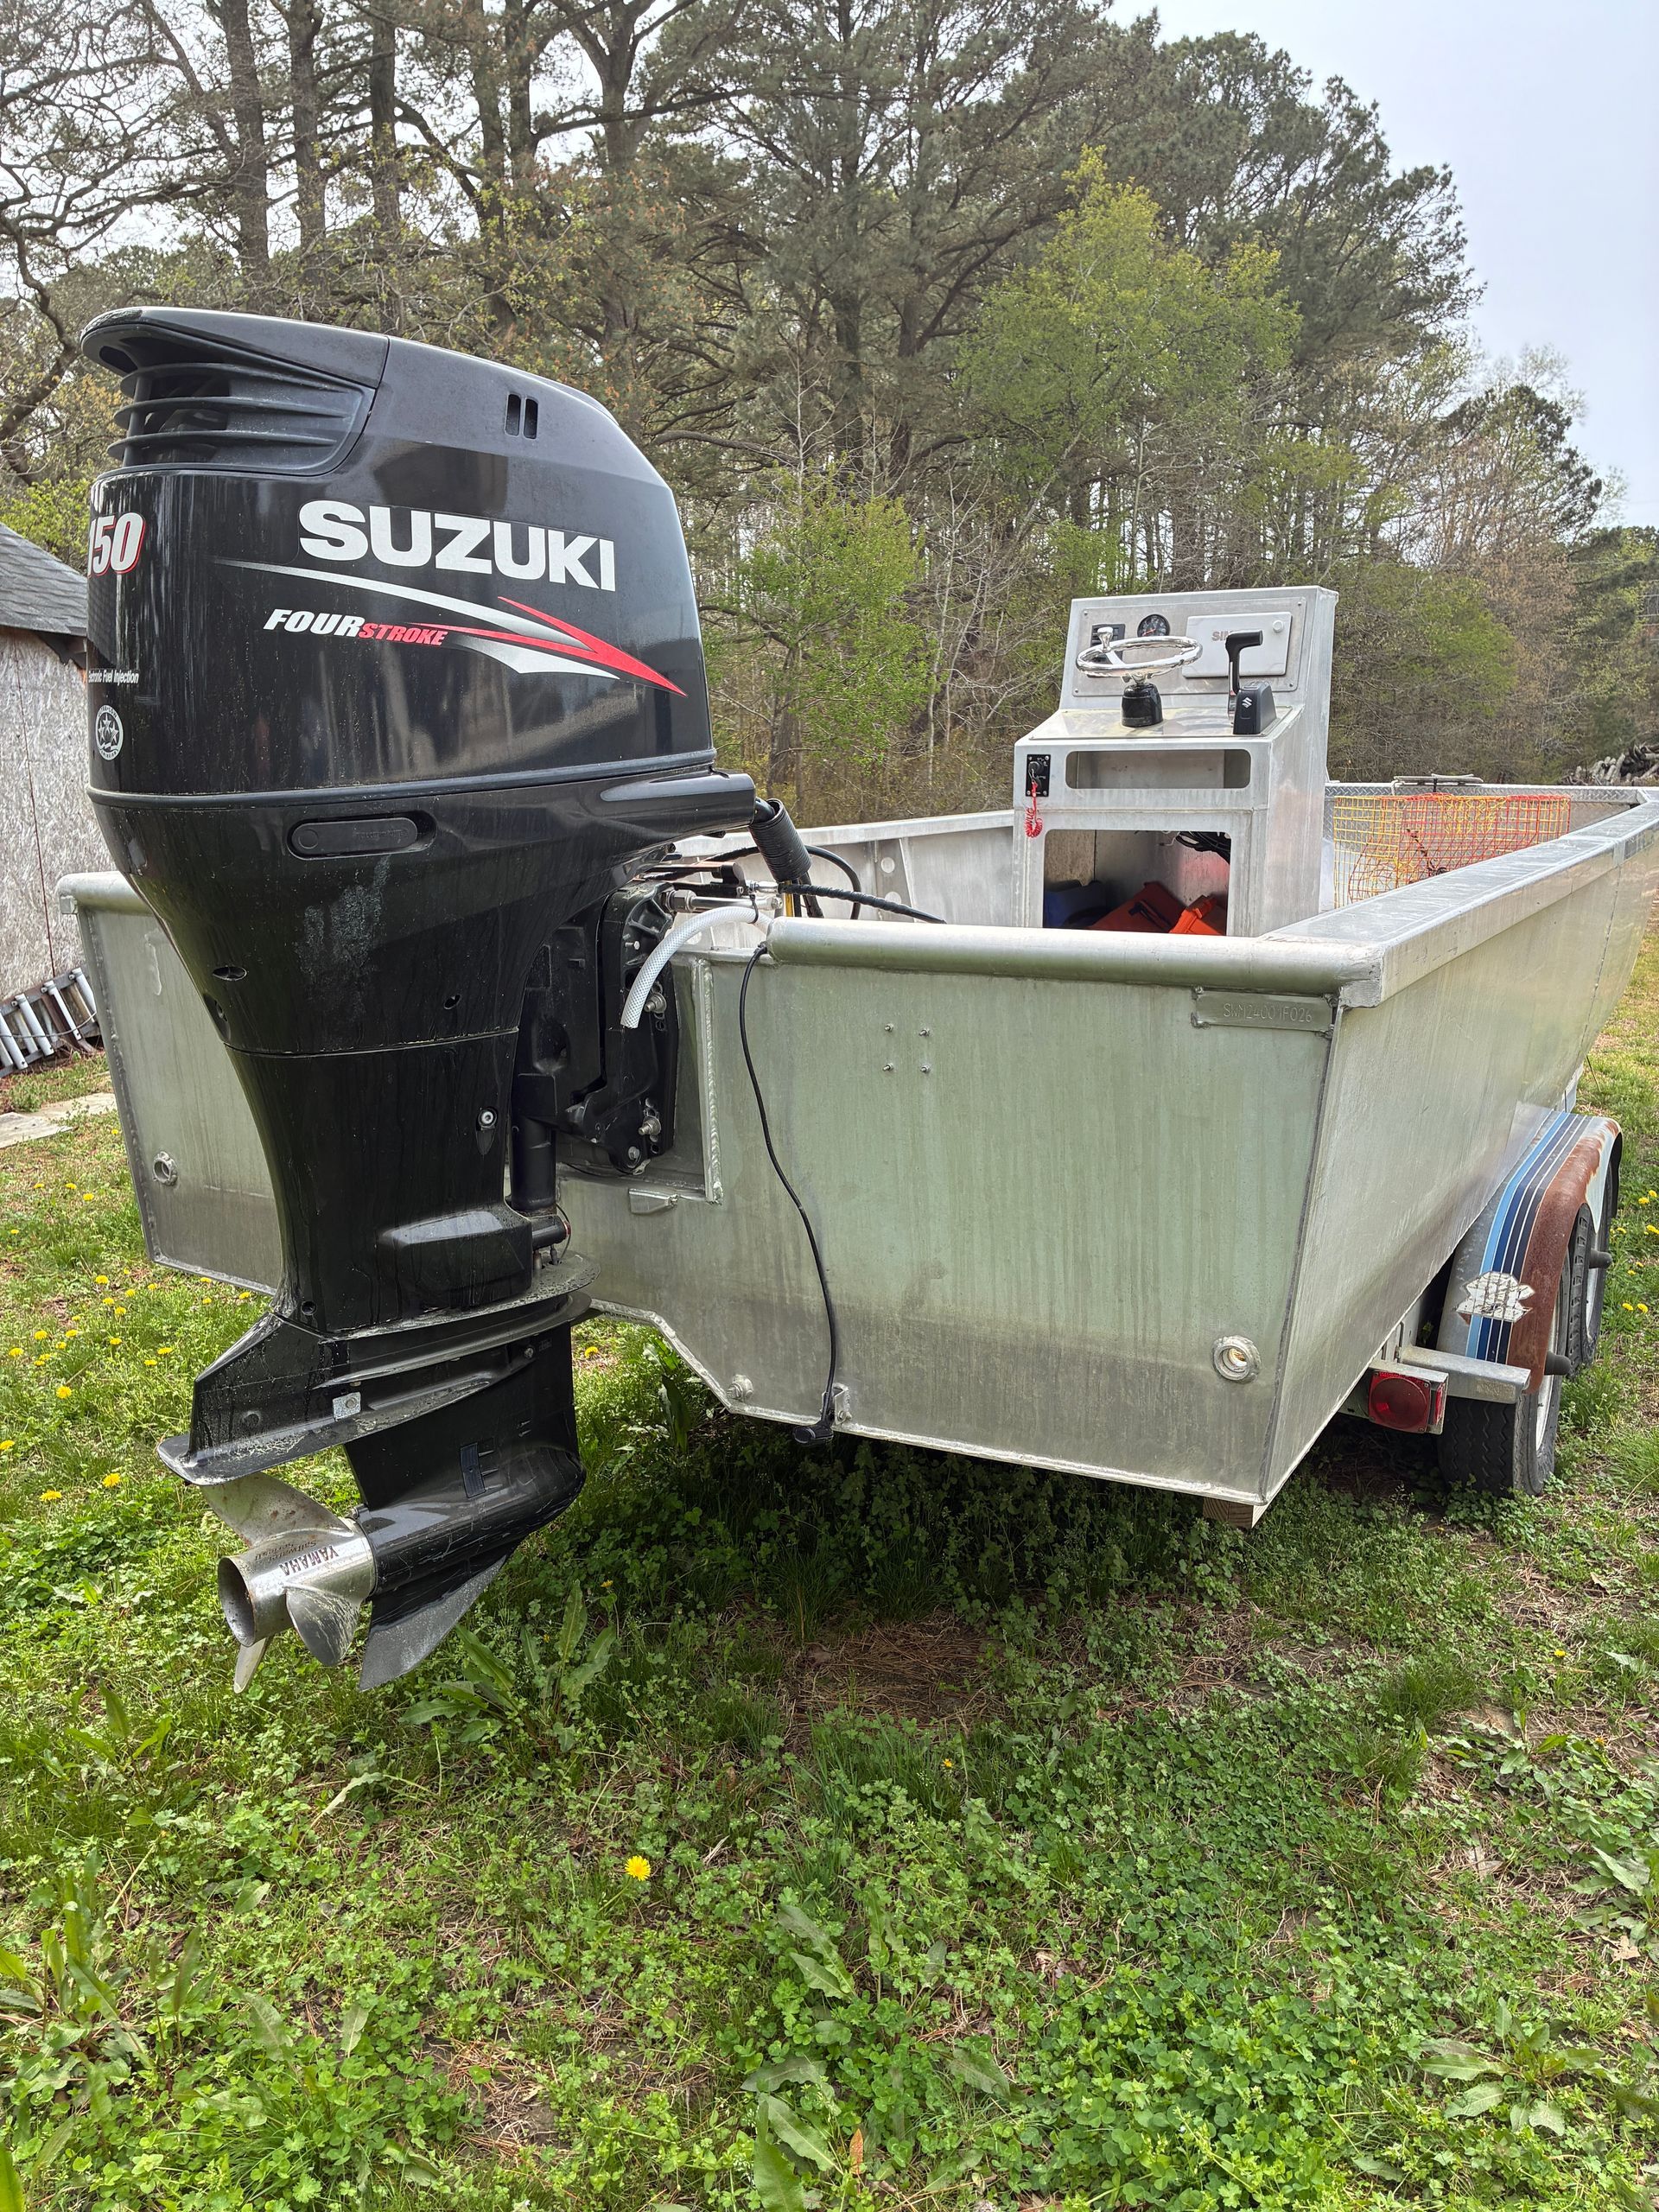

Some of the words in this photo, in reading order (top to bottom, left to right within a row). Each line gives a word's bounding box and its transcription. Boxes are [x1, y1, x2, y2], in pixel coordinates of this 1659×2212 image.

[299, 499, 616, 592] SUZUKI
[102, 669, 114, 683] Fuel
[113, 669, 140, 686] Injection
[278, 1545, 340, 1576] YAMAHA
